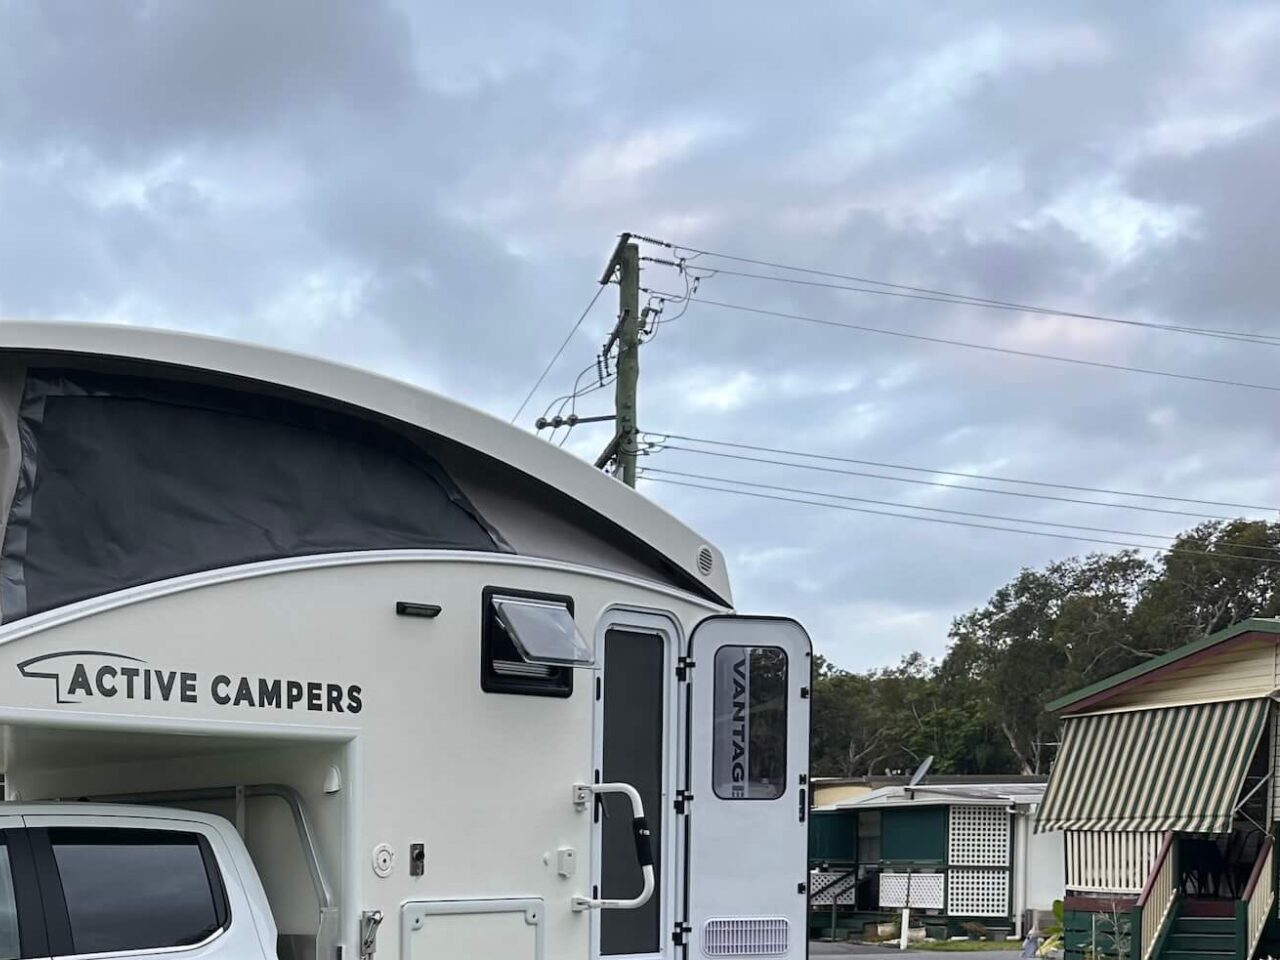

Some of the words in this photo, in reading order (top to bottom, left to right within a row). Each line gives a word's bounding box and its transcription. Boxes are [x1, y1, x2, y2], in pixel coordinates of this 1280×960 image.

[67, 663, 198, 704] ACTIVE
[210, 674, 363, 714] CAMPERS
[731, 658, 746, 798] VANTAGE
